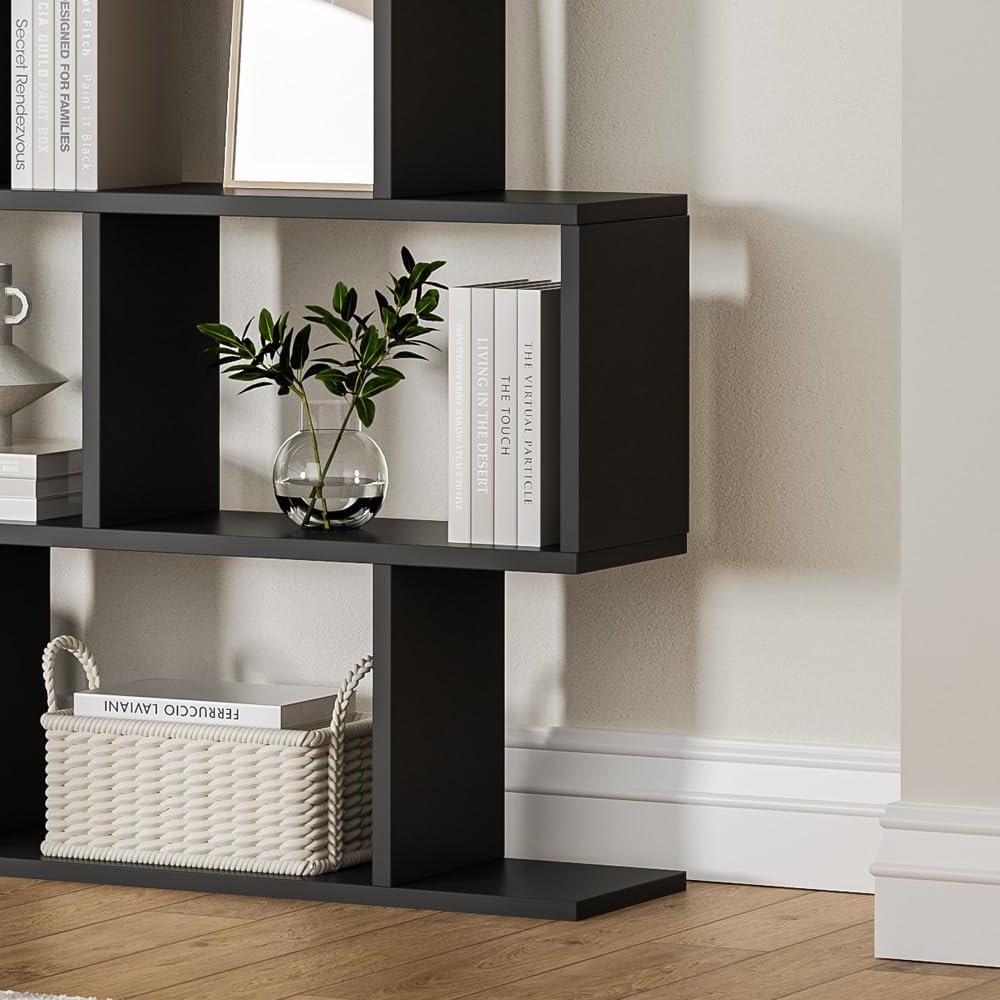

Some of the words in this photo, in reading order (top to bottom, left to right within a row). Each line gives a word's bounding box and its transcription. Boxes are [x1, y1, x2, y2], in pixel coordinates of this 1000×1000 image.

[15, 18, 29, 70] Secret
[36, 34, 49, 77] GUILD
[80, 20, 93, 57] Fitch
[59, 63, 70, 90] FOR
[80, 73, 93, 110] Paint
[15, 74, 29, 171] Rendezvous
[36, 127, 49, 153] BOX
[59, 93, 70, 152] FAMILIES
[80, 134, 93, 171] Black
[476, 337, 489, 387] LIVING
[523, 341, 533, 369] THE
[476, 392, 489, 406] IN
[500, 375, 511, 401] THE
[523, 375, 533, 434] VIRTUAL
[476, 408, 489, 439] THE
[500, 407, 511, 456] TOUCH
[476, 442, 489, 495] DESERT
[523, 440, 533, 505] PARTICLE
[104, 701, 159, 715] LAVIANI
[164, 704, 240, 721] FERRUCCIO
